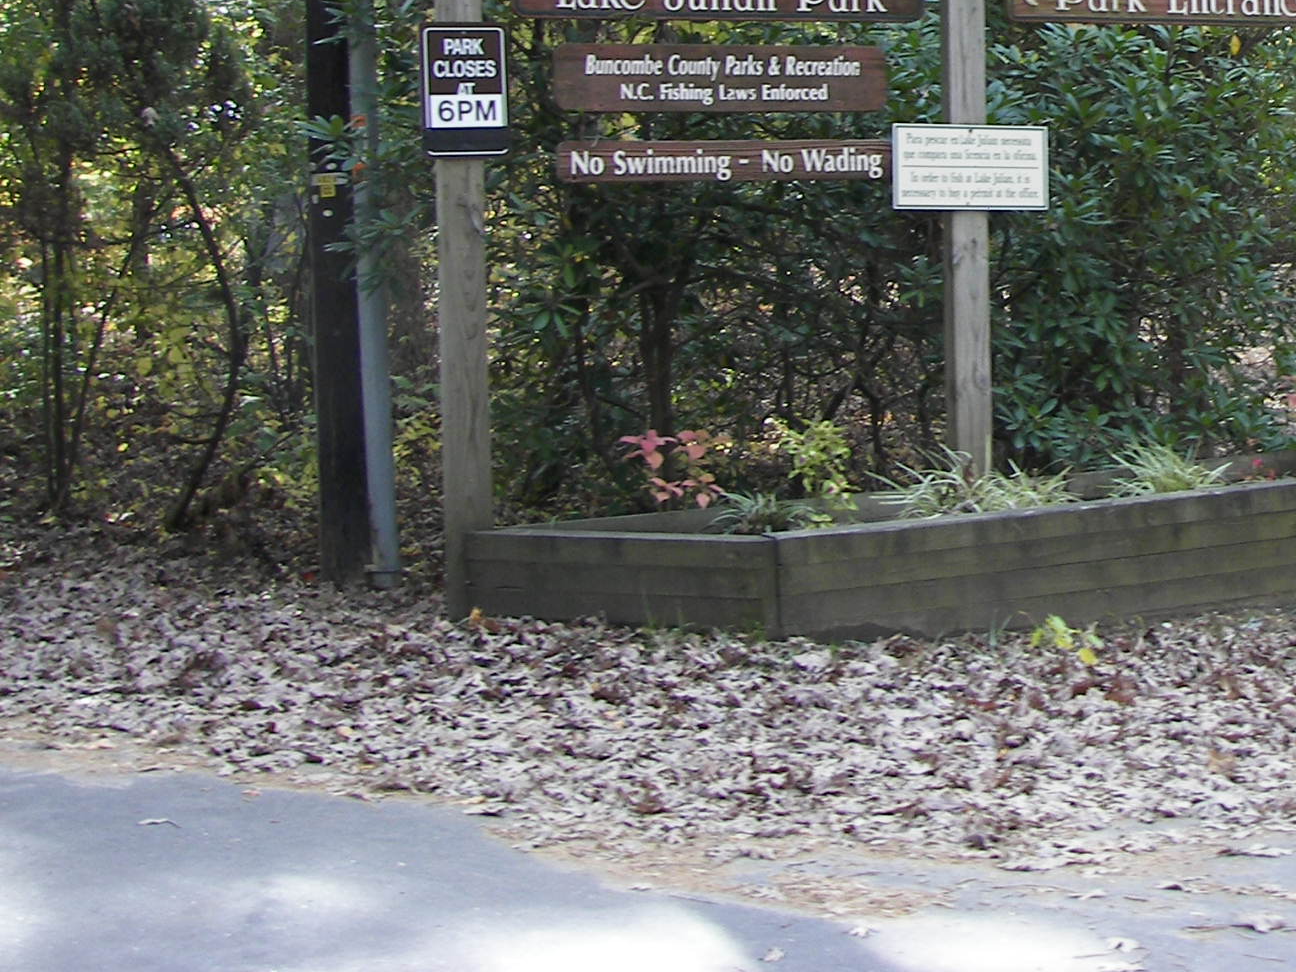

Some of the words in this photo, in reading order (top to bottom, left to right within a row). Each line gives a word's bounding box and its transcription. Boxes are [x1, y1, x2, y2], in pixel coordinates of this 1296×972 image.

[443, 38, 485, 55] PARK
[433, 59, 497, 78] CLOSES
[584, 54, 663, 75] Buncombe
[667, 54, 721, 81] County
[725, 54, 763, 76] Parks
[767, 55, 781, 76] &
[785, 55, 860, 76] Recreation
[457, 82, 476, 95] AT
[620, 83, 654, 100] N.C.
[659, 83, 713, 105] Fishing
[719, 84, 757, 100] Laws
[761, 83, 828, 100] Enforced
[438, 100, 497, 122] 6PM
[570, 150, 604, 175] No
[613, 148, 732, 180] Swimming
[762, 149, 794, 173] No
[801, 147, 884, 178] Wading
